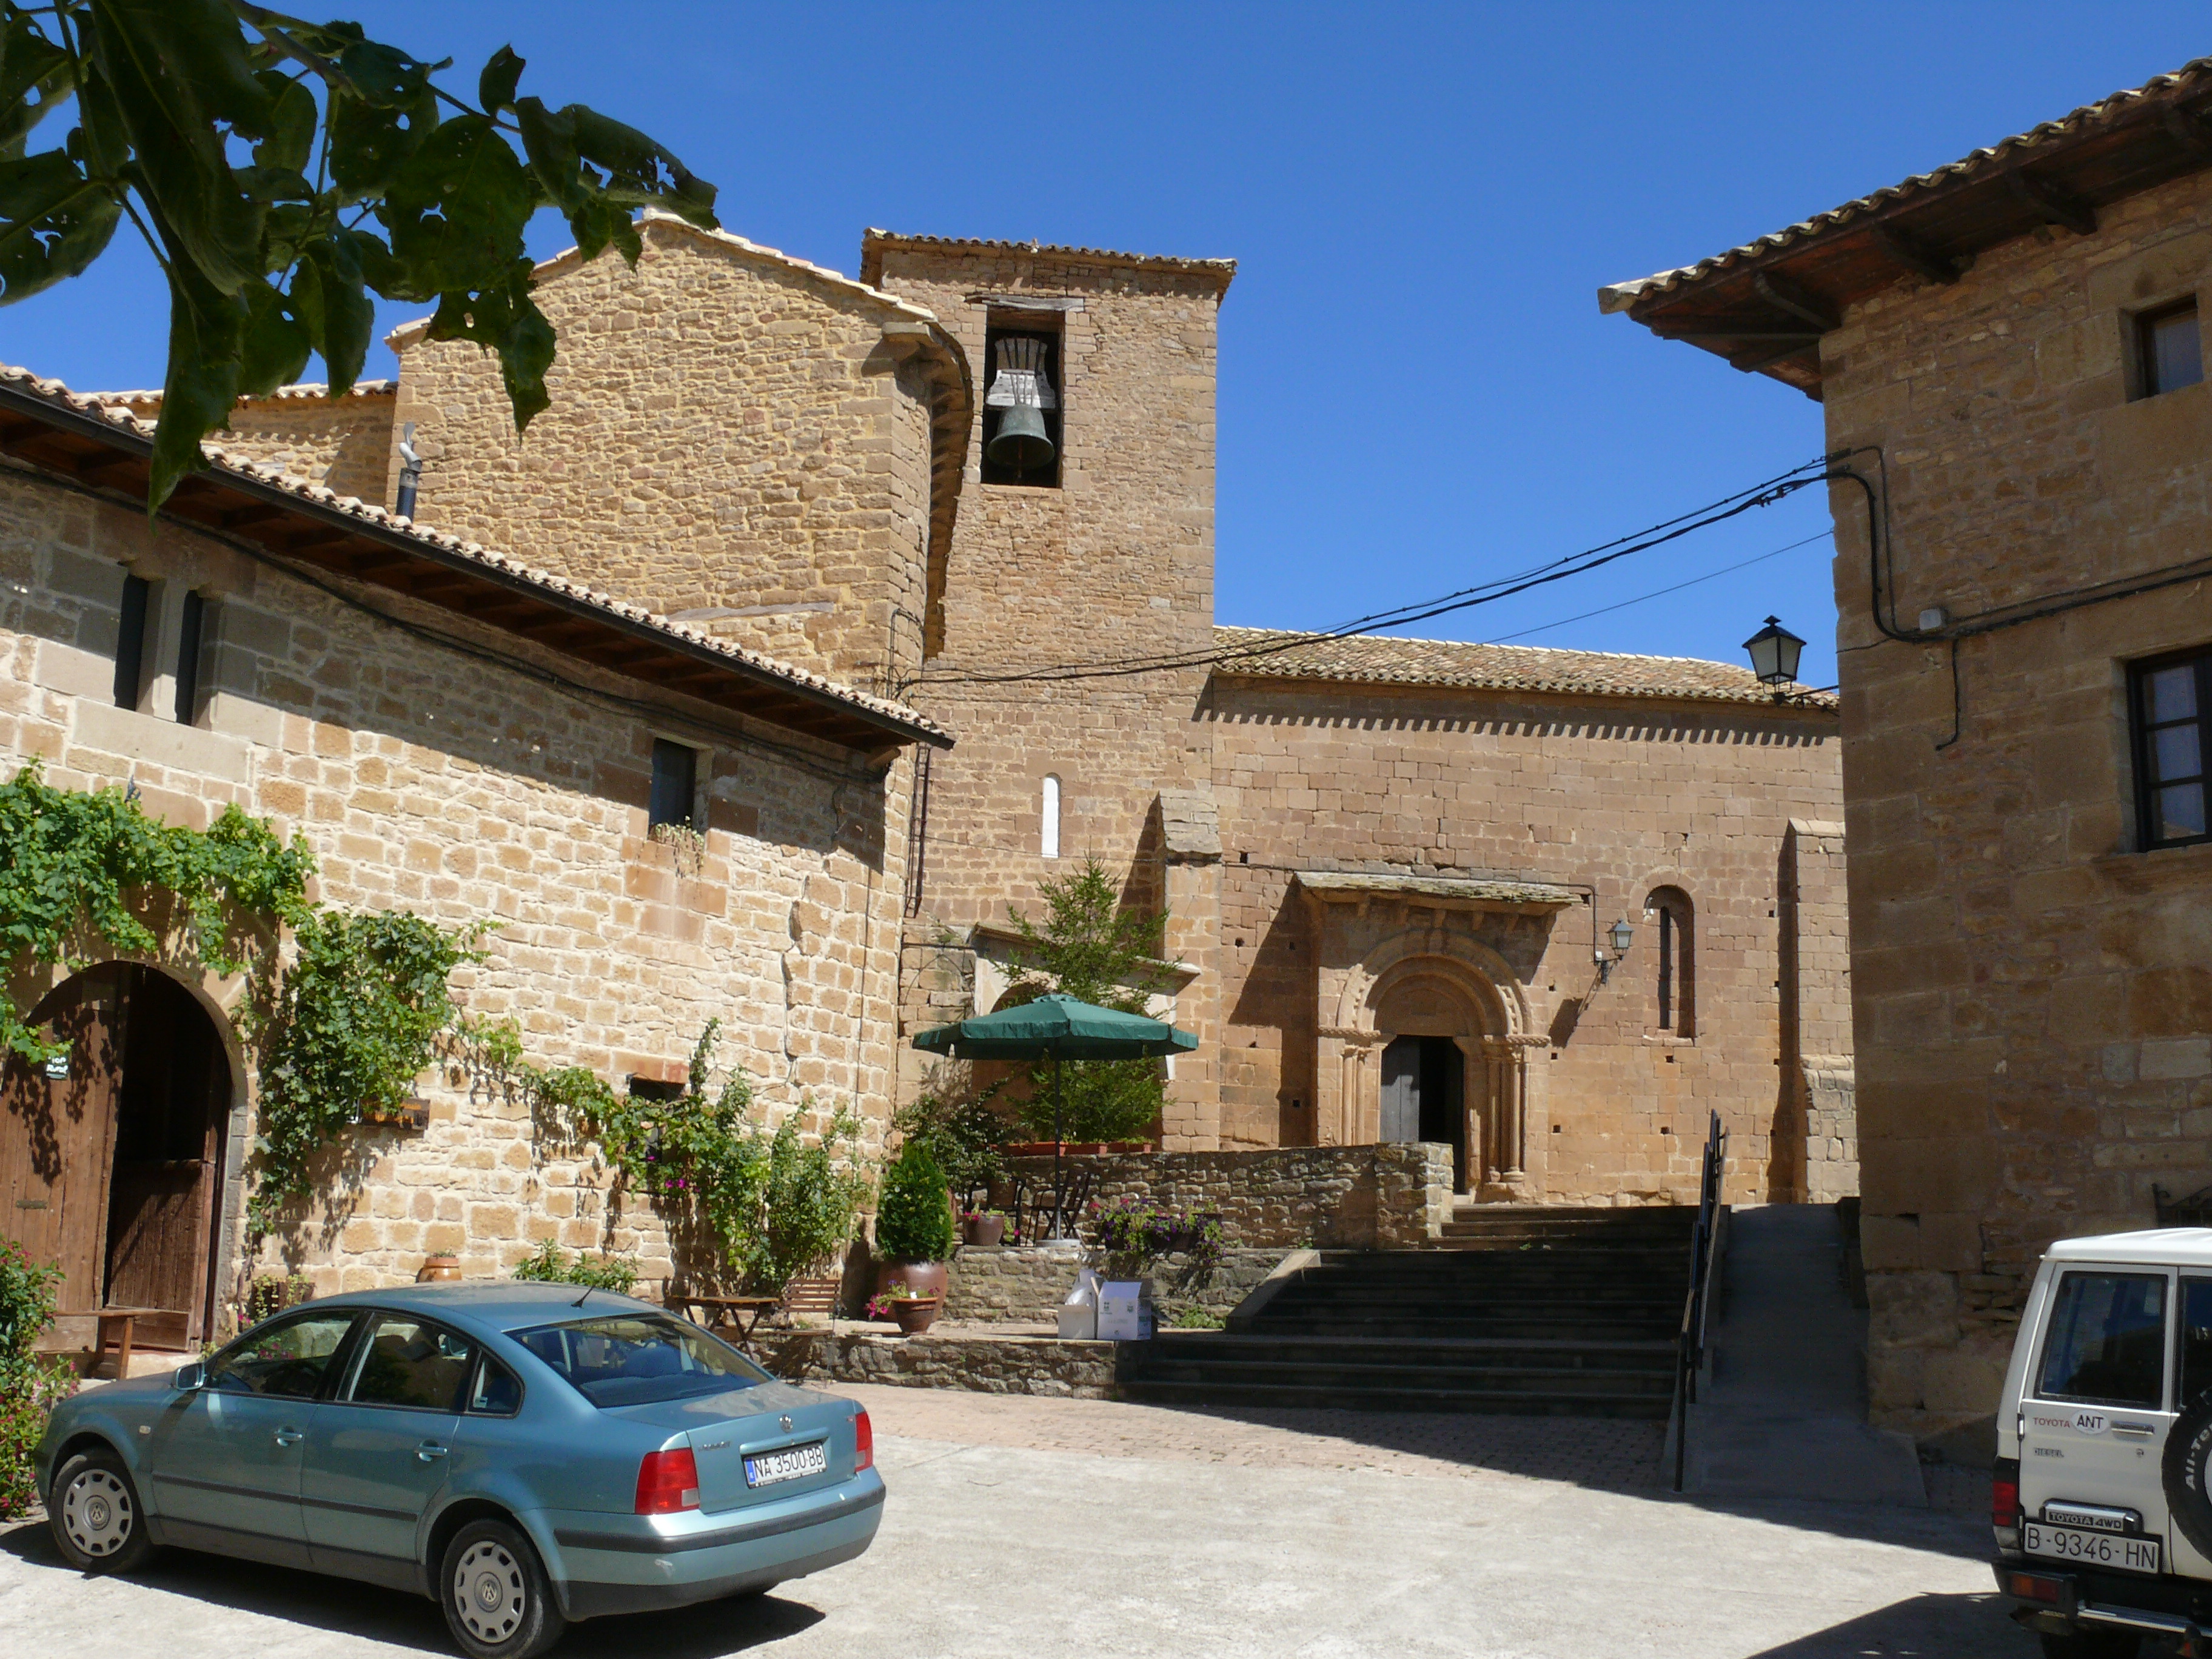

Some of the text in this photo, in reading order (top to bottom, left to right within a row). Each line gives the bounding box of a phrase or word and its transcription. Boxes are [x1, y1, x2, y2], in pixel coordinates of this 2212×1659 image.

[2033, 1416, 2070, 1428] TOYOTA
[2076, 1414, 2104, 1429] ANT
[754, 1458, 773, 1478] NA
[774, 1450, 806, 1473] 3500
[808, 1446, 823, 1467] BB
[2049, 1512, 2122, 1529] TOYOTA 4WD
